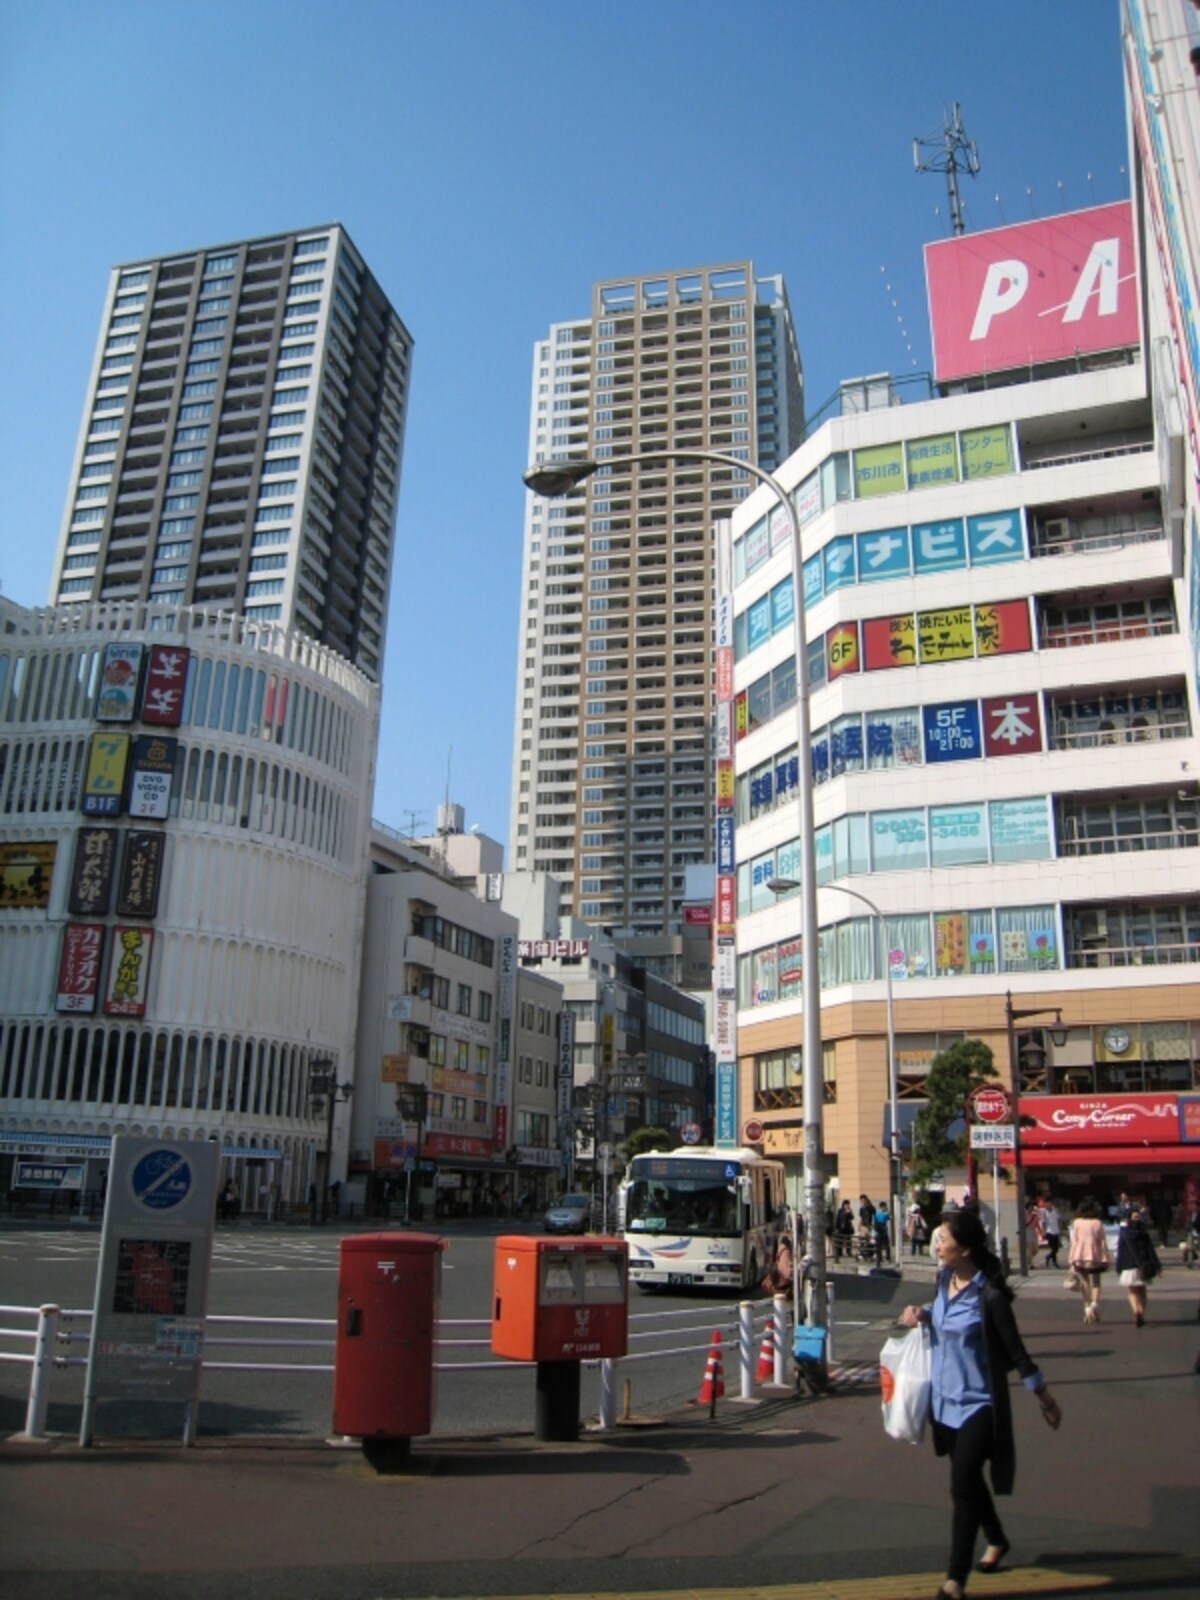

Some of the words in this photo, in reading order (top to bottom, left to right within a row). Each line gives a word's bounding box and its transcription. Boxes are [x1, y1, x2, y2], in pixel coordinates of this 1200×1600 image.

[831, 641, 854, 668] 6F
[937, 707, 967, 727] 5F
[991, 701, 1033, 746] 本
[940, 736, 974, 751] 21:00
[137, 783, 167, 793] VIDEO
[85, 796, 117, 812] B1F
[143, 792, 159, 801] CD
[139, 803, 158, 814] 2F
[78, 830, 109, 902] 甘太郎
[76, 927, 101, 992] カラオケ
[66, 996, 86, 1009] 3F
